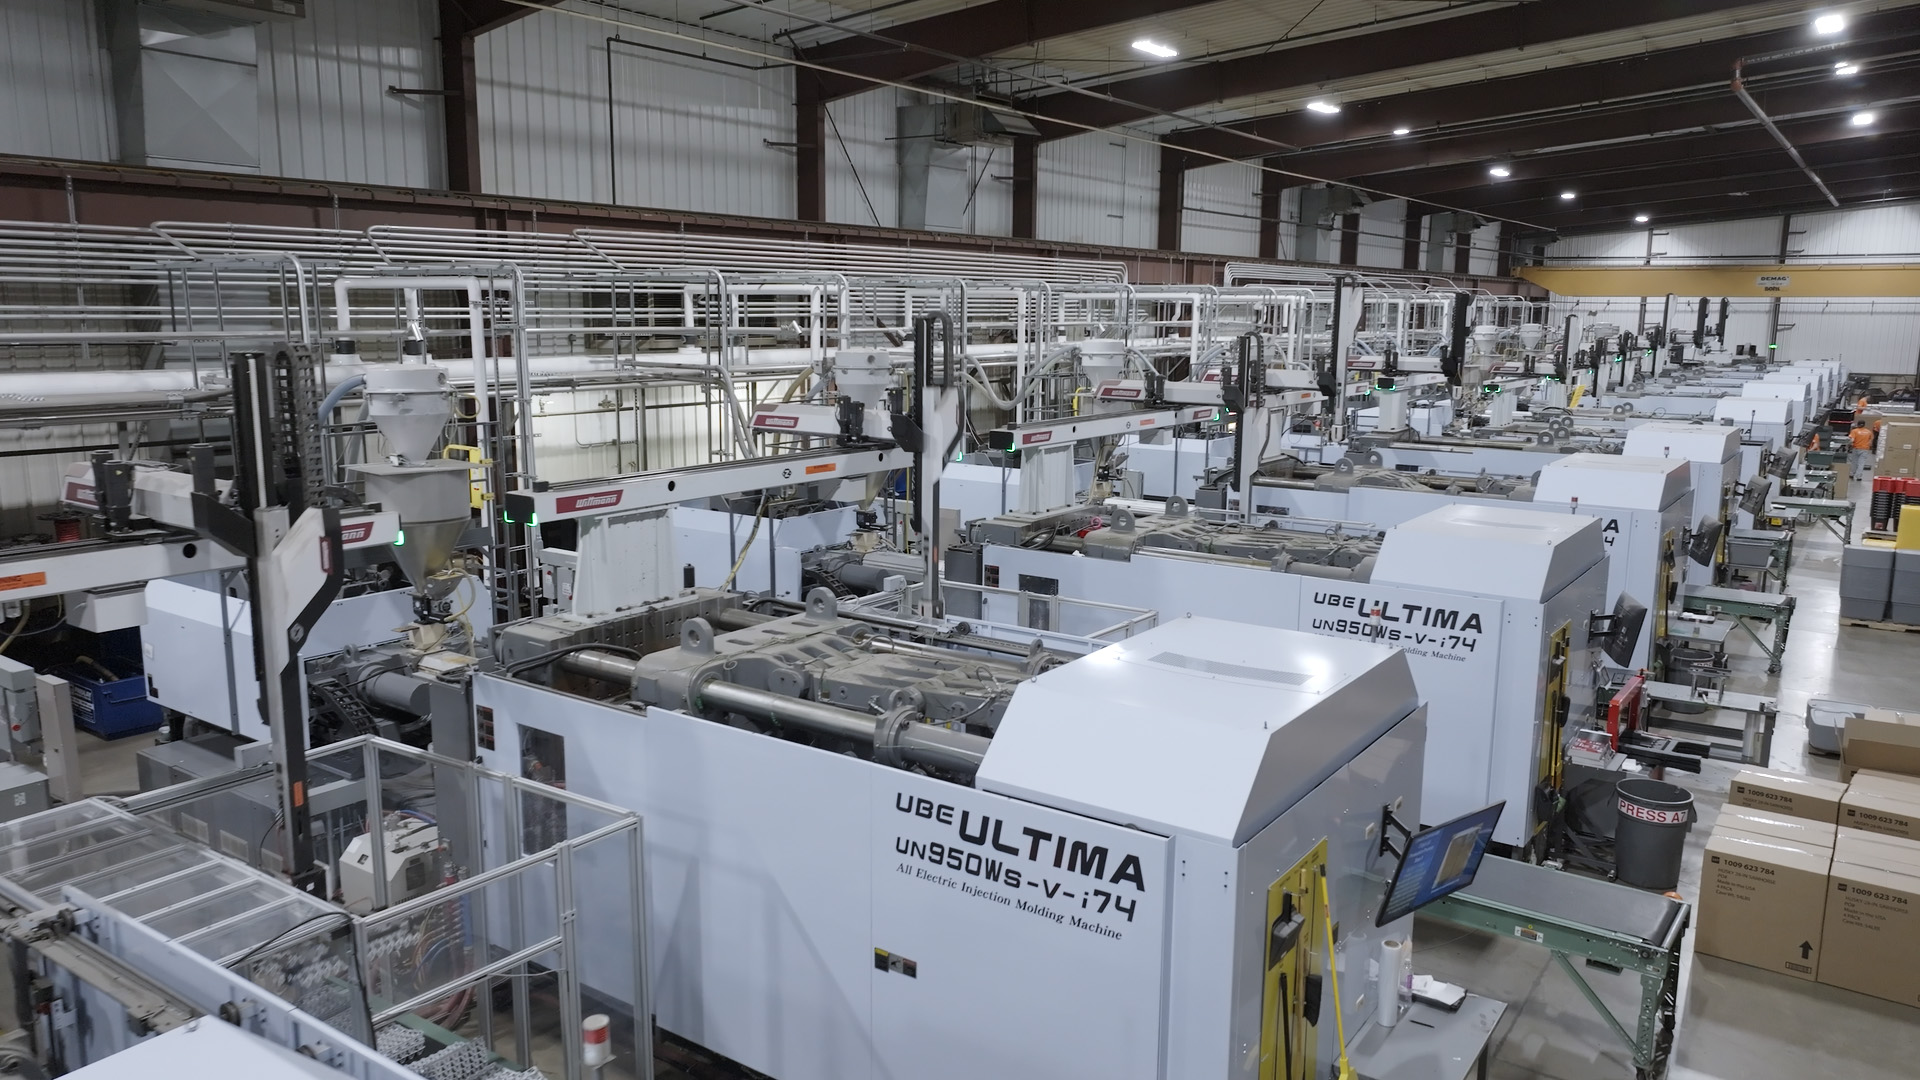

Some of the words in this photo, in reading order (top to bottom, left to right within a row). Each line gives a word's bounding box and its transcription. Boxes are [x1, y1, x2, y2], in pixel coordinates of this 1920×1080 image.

[1313, 592, 1356, 608] UBE
[1357, 598, 1482, 634] ULTIMA
[1400, 646, 1428, 657] olding
[1430, 650, 1466, 662] Machine
[1620, 800, 1667, 823] PRESS
[895, 792, 954, 825] UBE
[958, 810, 1146, 892] ULTIMA
[1724, 859, 1743, 868] 1009
[1744, 864, 1758, 872] 623
[1760, 867, 1775, 875] 784
[896, 862, 912, 876] All
[915, 866, 957, 889] Electric
[961, 881, 1011, 906] Injection
[1015, 898, 1065, 924] Molding
[1069, 915, 1123, 940] Machine
[1851, 887, 1872, 896] 1009
[1873, 892, 1889, 901] 623
[1892, 896, 1908, 904] 784
